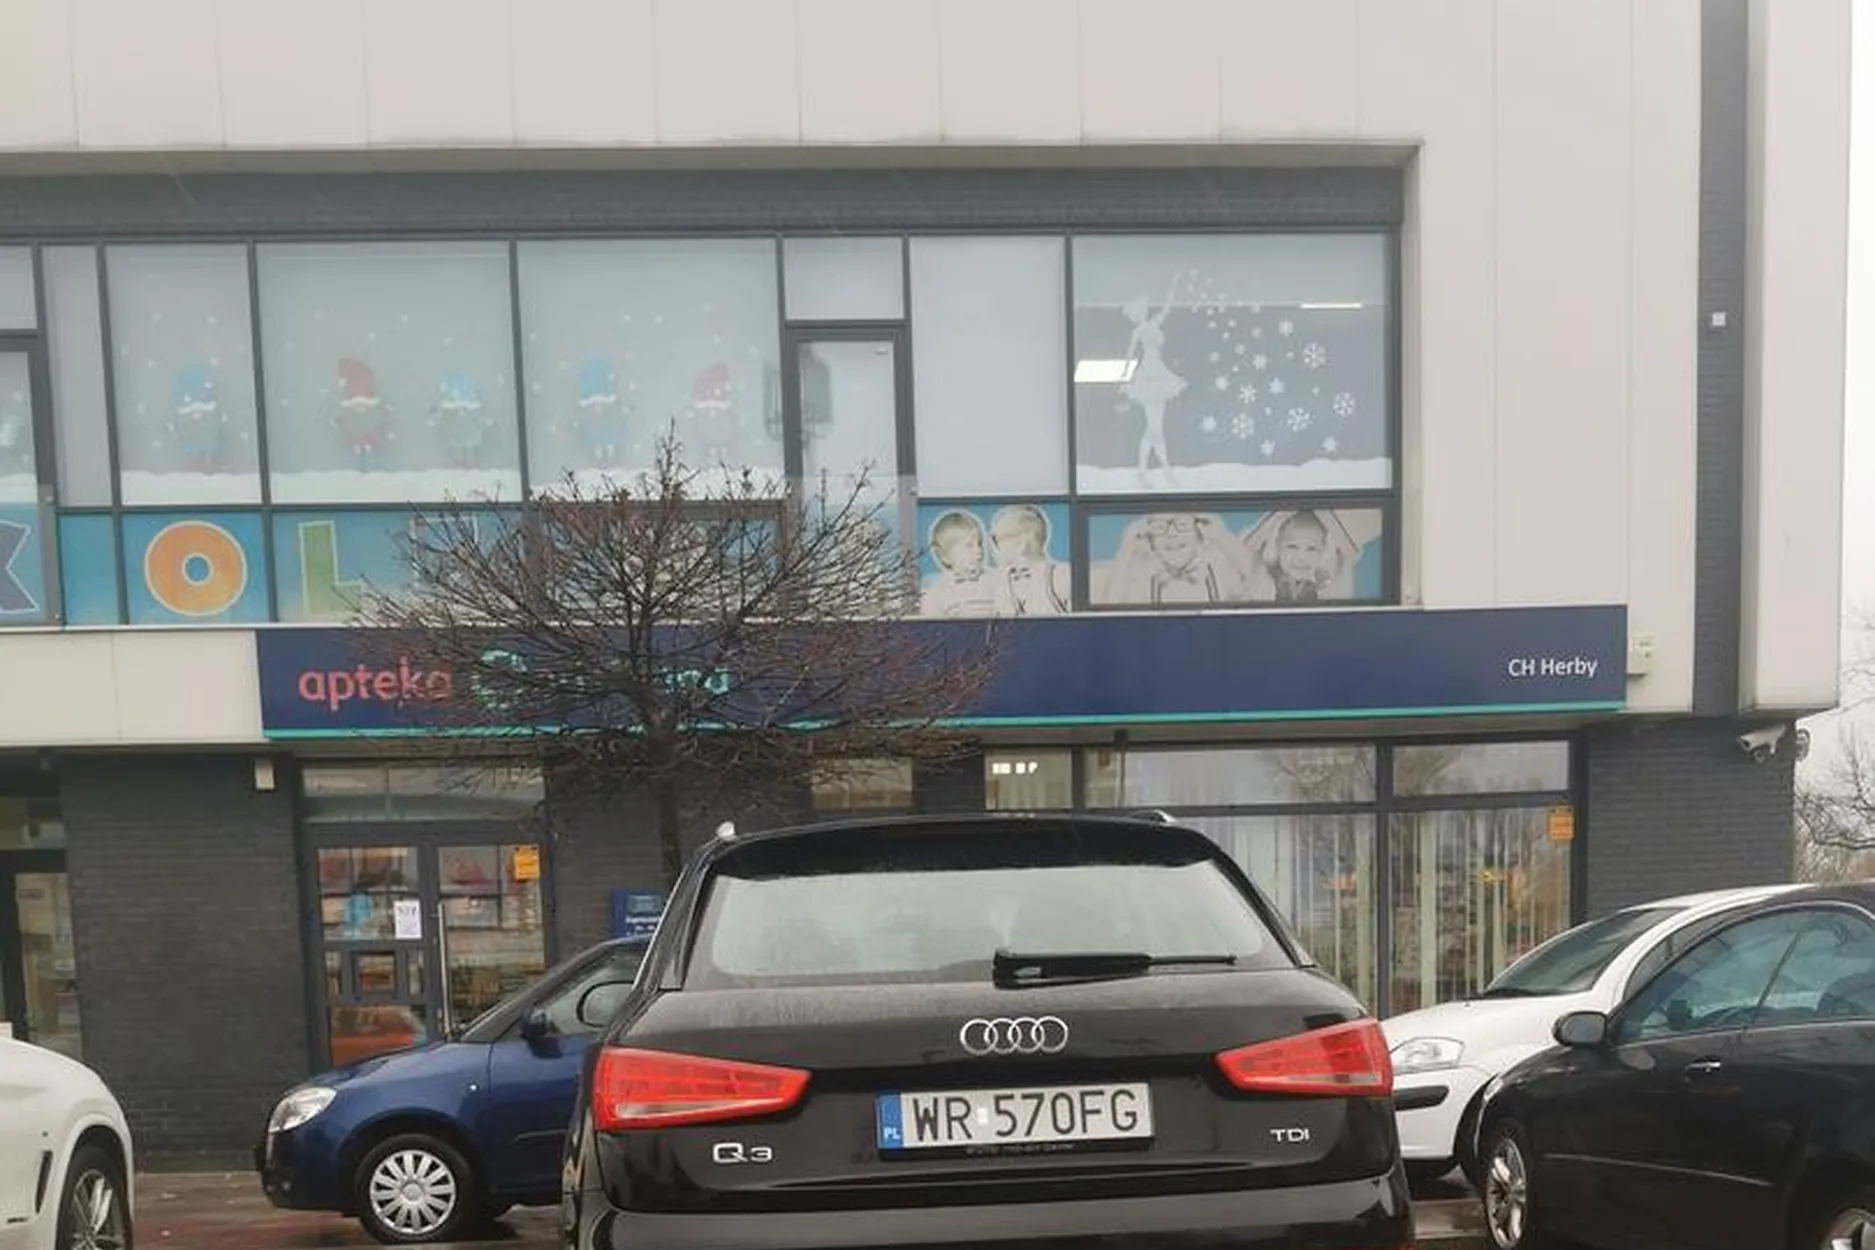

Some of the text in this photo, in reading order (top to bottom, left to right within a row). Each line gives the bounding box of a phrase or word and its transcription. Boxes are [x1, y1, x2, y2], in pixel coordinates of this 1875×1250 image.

[1508, 656, 1598, 679] CH Herby
[298, 656, 452, 711] apteka
[912, 1088, 1138, 1142] WR 570FG
[883, 1126, 901, 1141] PL
[1269, 1128, 1310, 1142] TDI
[712, 1142, 772, 1164] Q3
